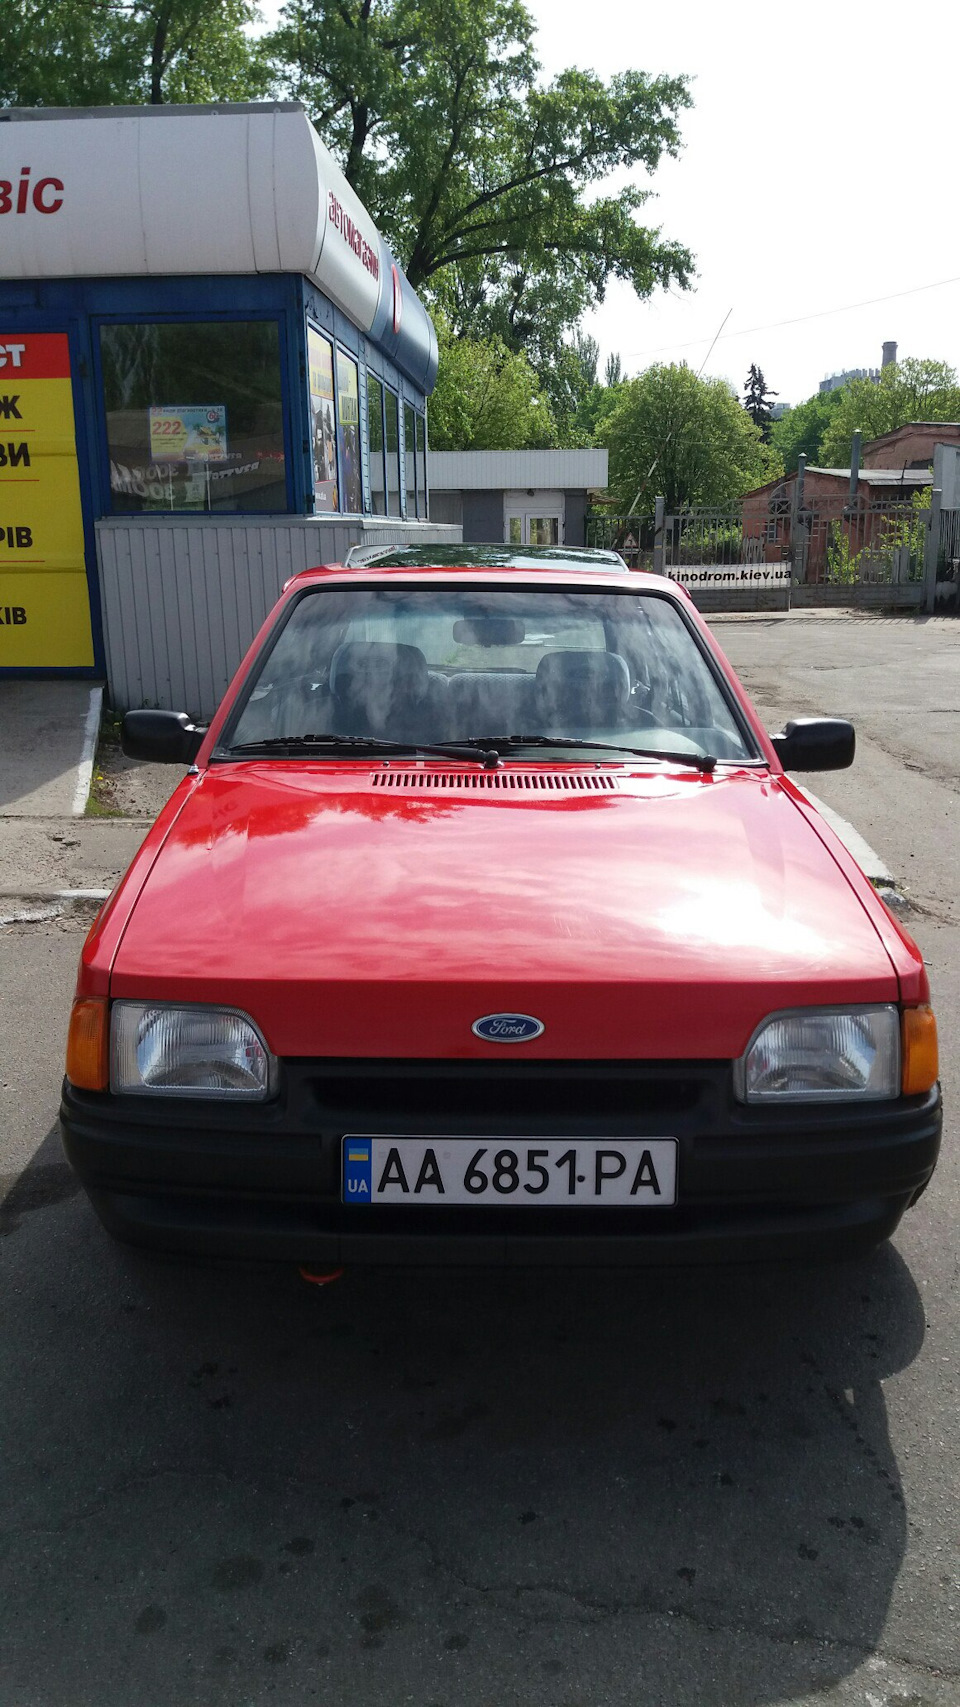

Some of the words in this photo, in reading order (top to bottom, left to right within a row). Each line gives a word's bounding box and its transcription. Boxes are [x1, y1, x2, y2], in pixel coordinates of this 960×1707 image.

[152, 420, 182, 435] 222
[667, 569, 792, 582] kinodrom.kiev.ua
[0, 606, 27, 625] ІВ
[489, 1019, 527, 1035] Ford
[348, 1179, 369, 1193] UA
[377, 1147, 445, 1194] AA
[463, 1148, 577, 1195] 6851
[595, 1149, 662, 1196] PA
